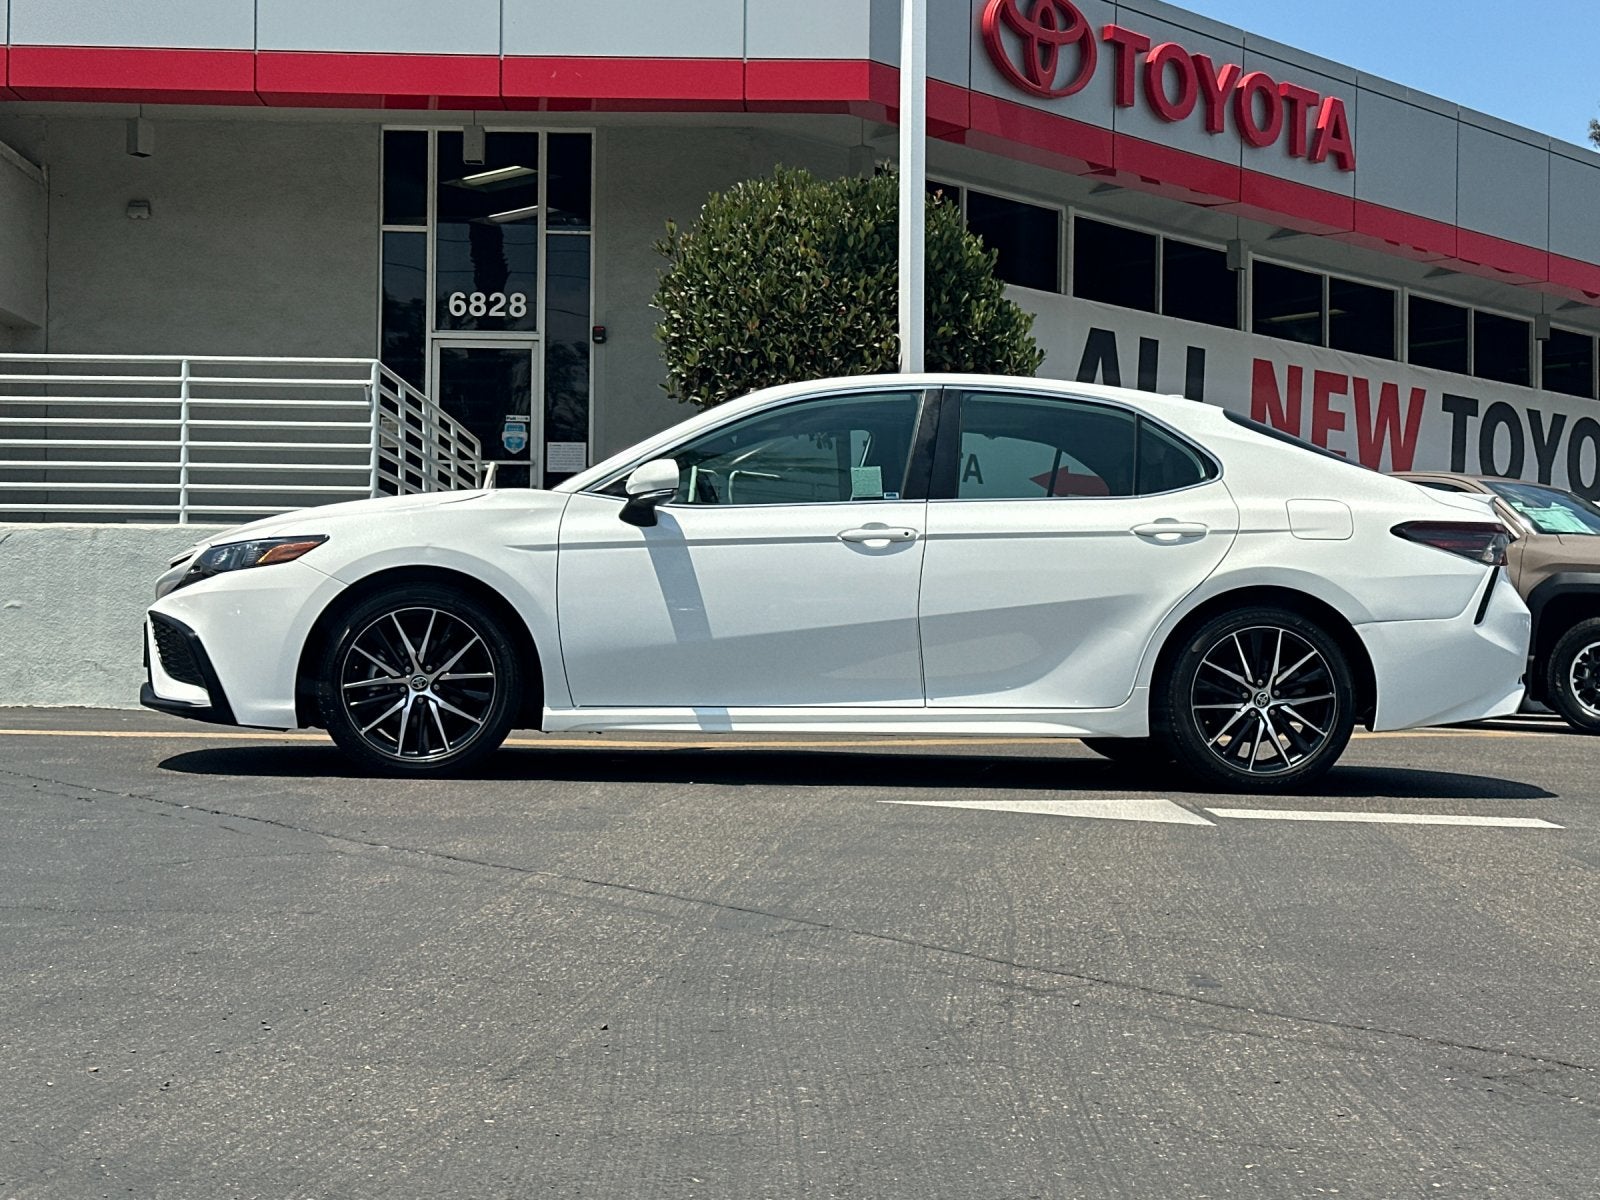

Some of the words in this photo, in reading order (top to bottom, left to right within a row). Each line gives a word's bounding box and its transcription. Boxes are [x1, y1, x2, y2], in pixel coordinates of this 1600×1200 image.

[1103, 23, 1356, 172] TOYOTA
[448, 291, 527, 318] 6828
[961, 452, 984, 485] A
[1250, 358, 1427, 473] NEW
[1441, 392, 1600, 502] TOYO
